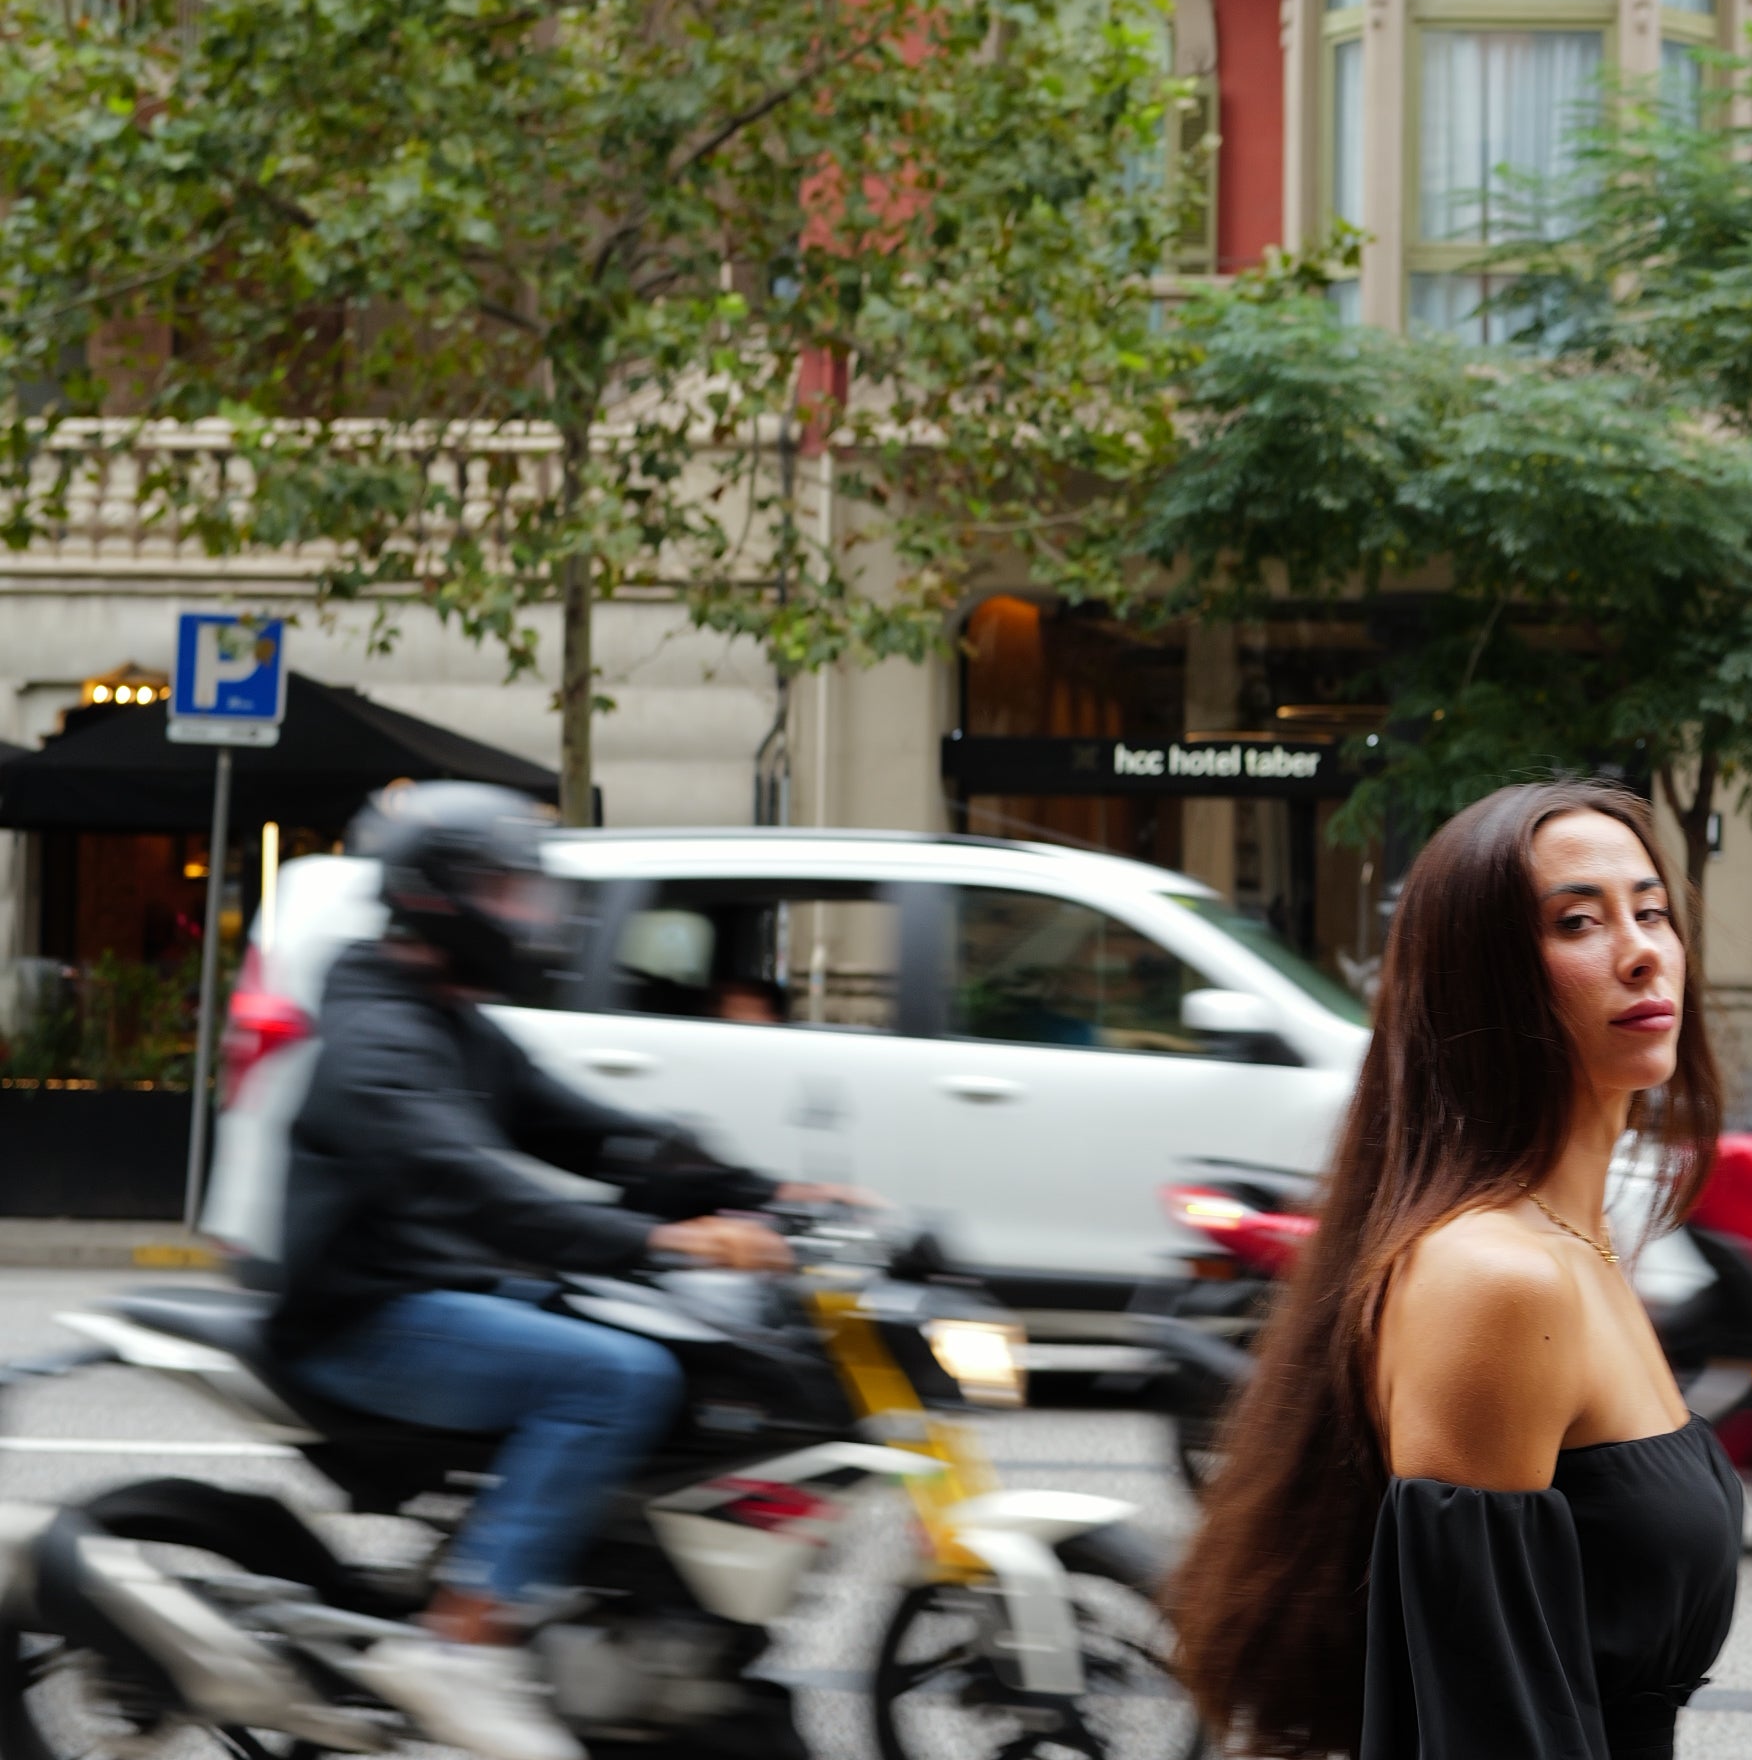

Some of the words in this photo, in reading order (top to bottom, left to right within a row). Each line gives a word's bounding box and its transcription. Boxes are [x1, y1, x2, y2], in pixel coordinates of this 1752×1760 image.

[193, 623, 261, 708] P
[1114, 742, 1165, 775] hcc
[1169, 743, 1242, 777] hotel
[1245, 745, 1321, 778] taber
